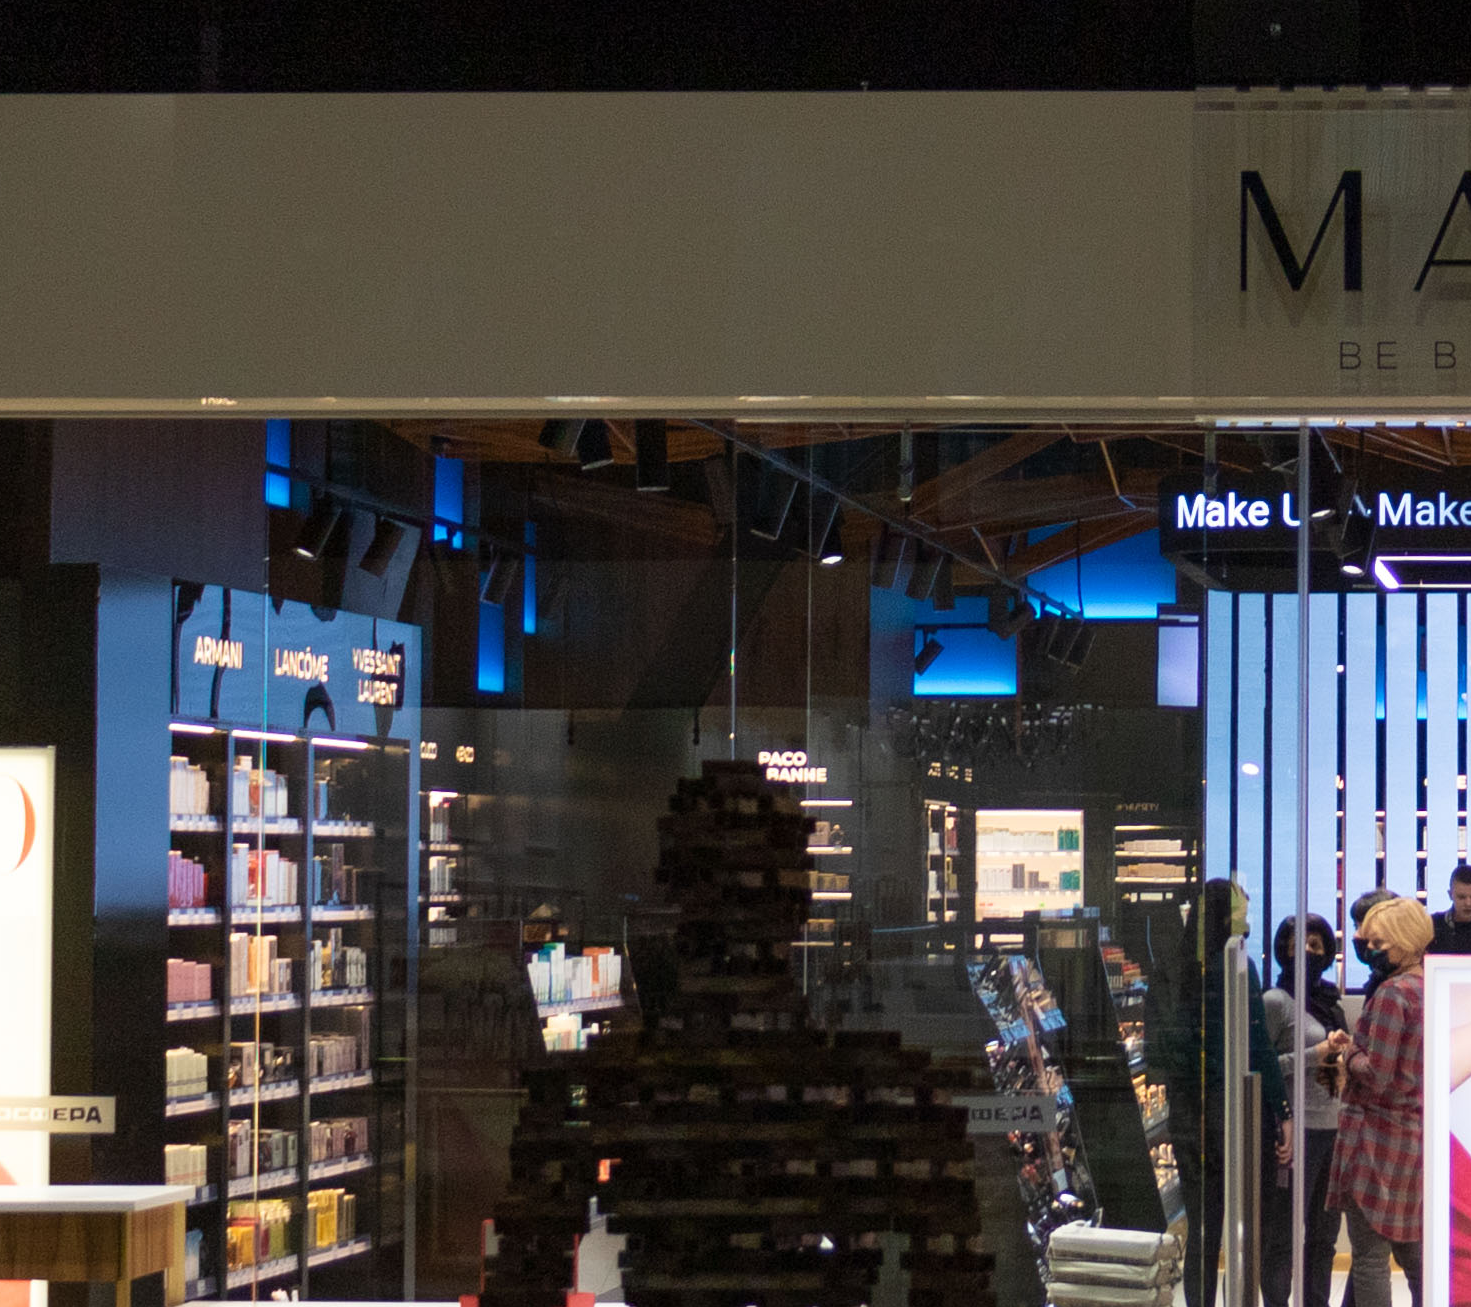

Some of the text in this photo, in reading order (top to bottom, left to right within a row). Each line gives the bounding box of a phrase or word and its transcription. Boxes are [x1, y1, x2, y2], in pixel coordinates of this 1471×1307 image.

[1339, 340, 1398, 371] BE
[1177, 491, 1270, 529] Make
[193, 636, 243, 670] ARMANI
[352, 647, 375, 674] YVES
[758, 751, 808, 767] PACO
